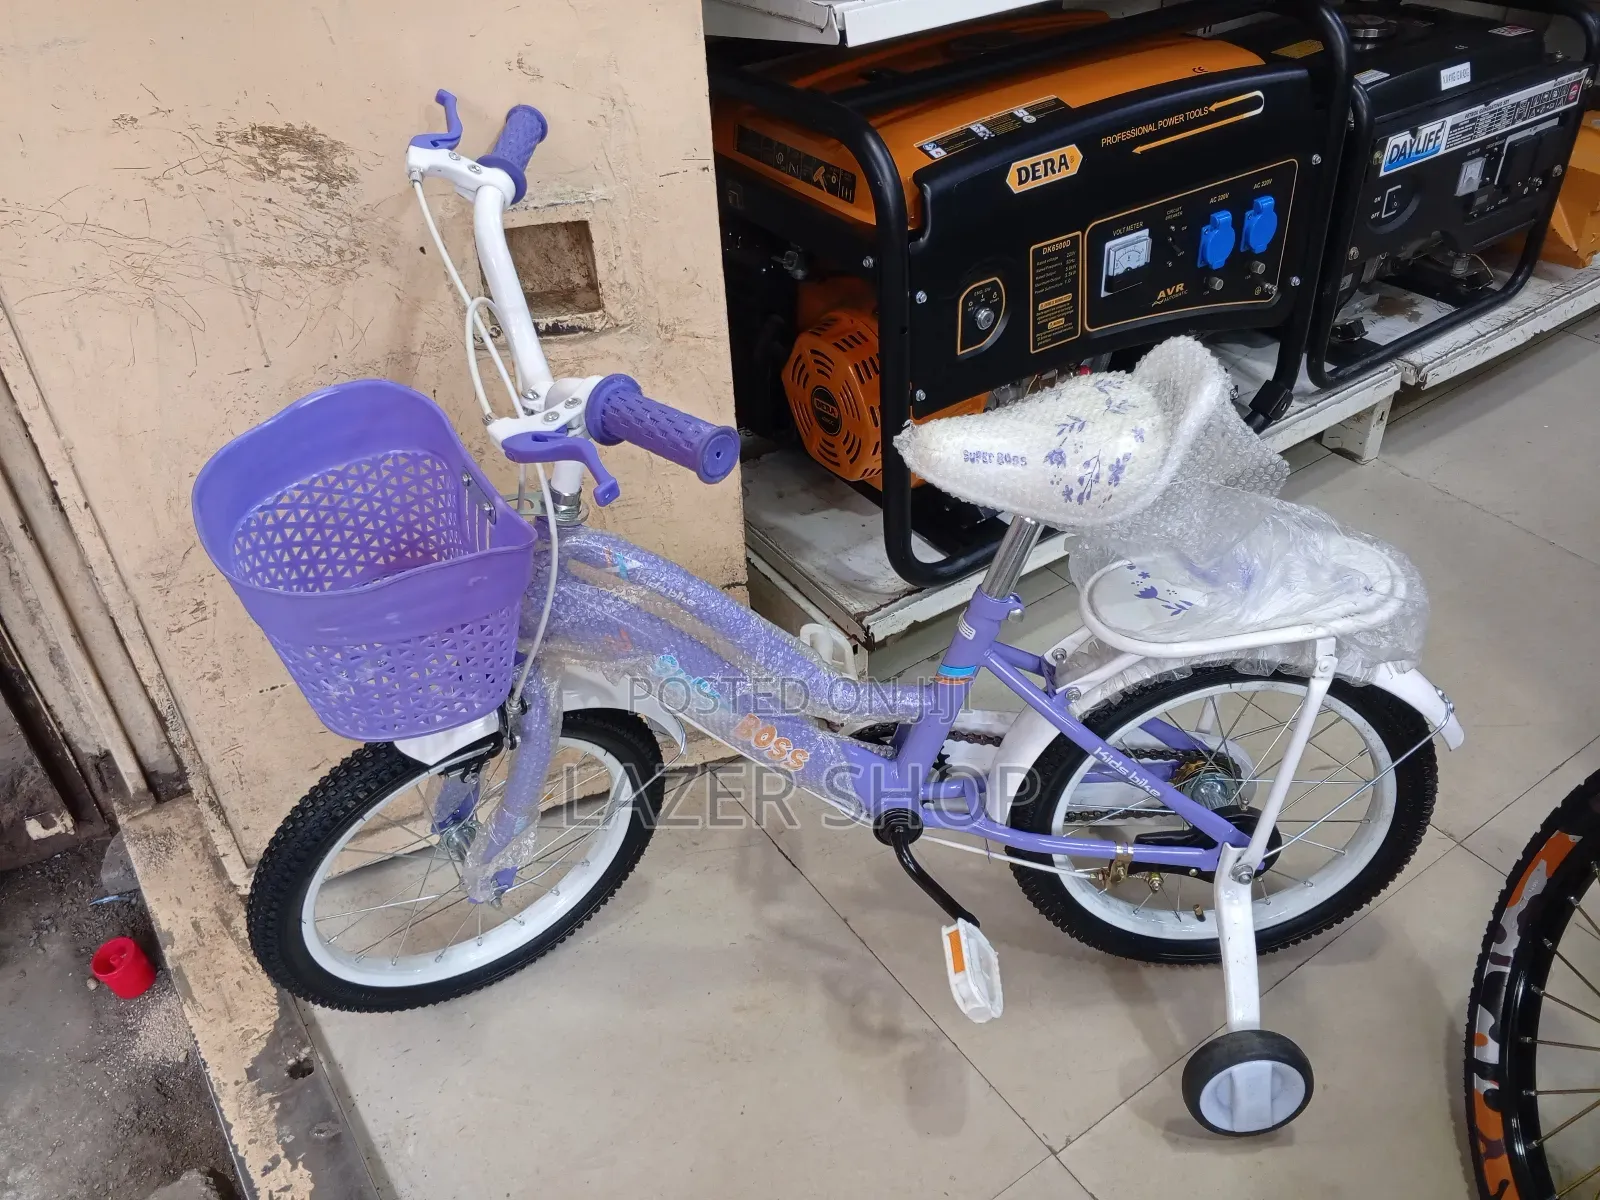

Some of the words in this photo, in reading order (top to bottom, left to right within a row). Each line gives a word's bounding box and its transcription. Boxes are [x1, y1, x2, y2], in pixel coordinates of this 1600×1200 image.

[1101, 123, 1157, 147] PROFESSIONAL
[1157, 114, 1185, 130] POWER
[1185, 106, 1210, 121] TOOLS
[1017, 153, 1069, 186] DERA
[1125, 221, 1144, 232] METER
[1042, 239, 1071, 255] DK6500D
[1157, 282, 1185, 301] AVR
[963, 449, 995, 465] SUPER
[732, 712, 811, 772] BOSS
[1093, 746, 1130, 776] Kids
[1128, 771, 1161, 797] bike
